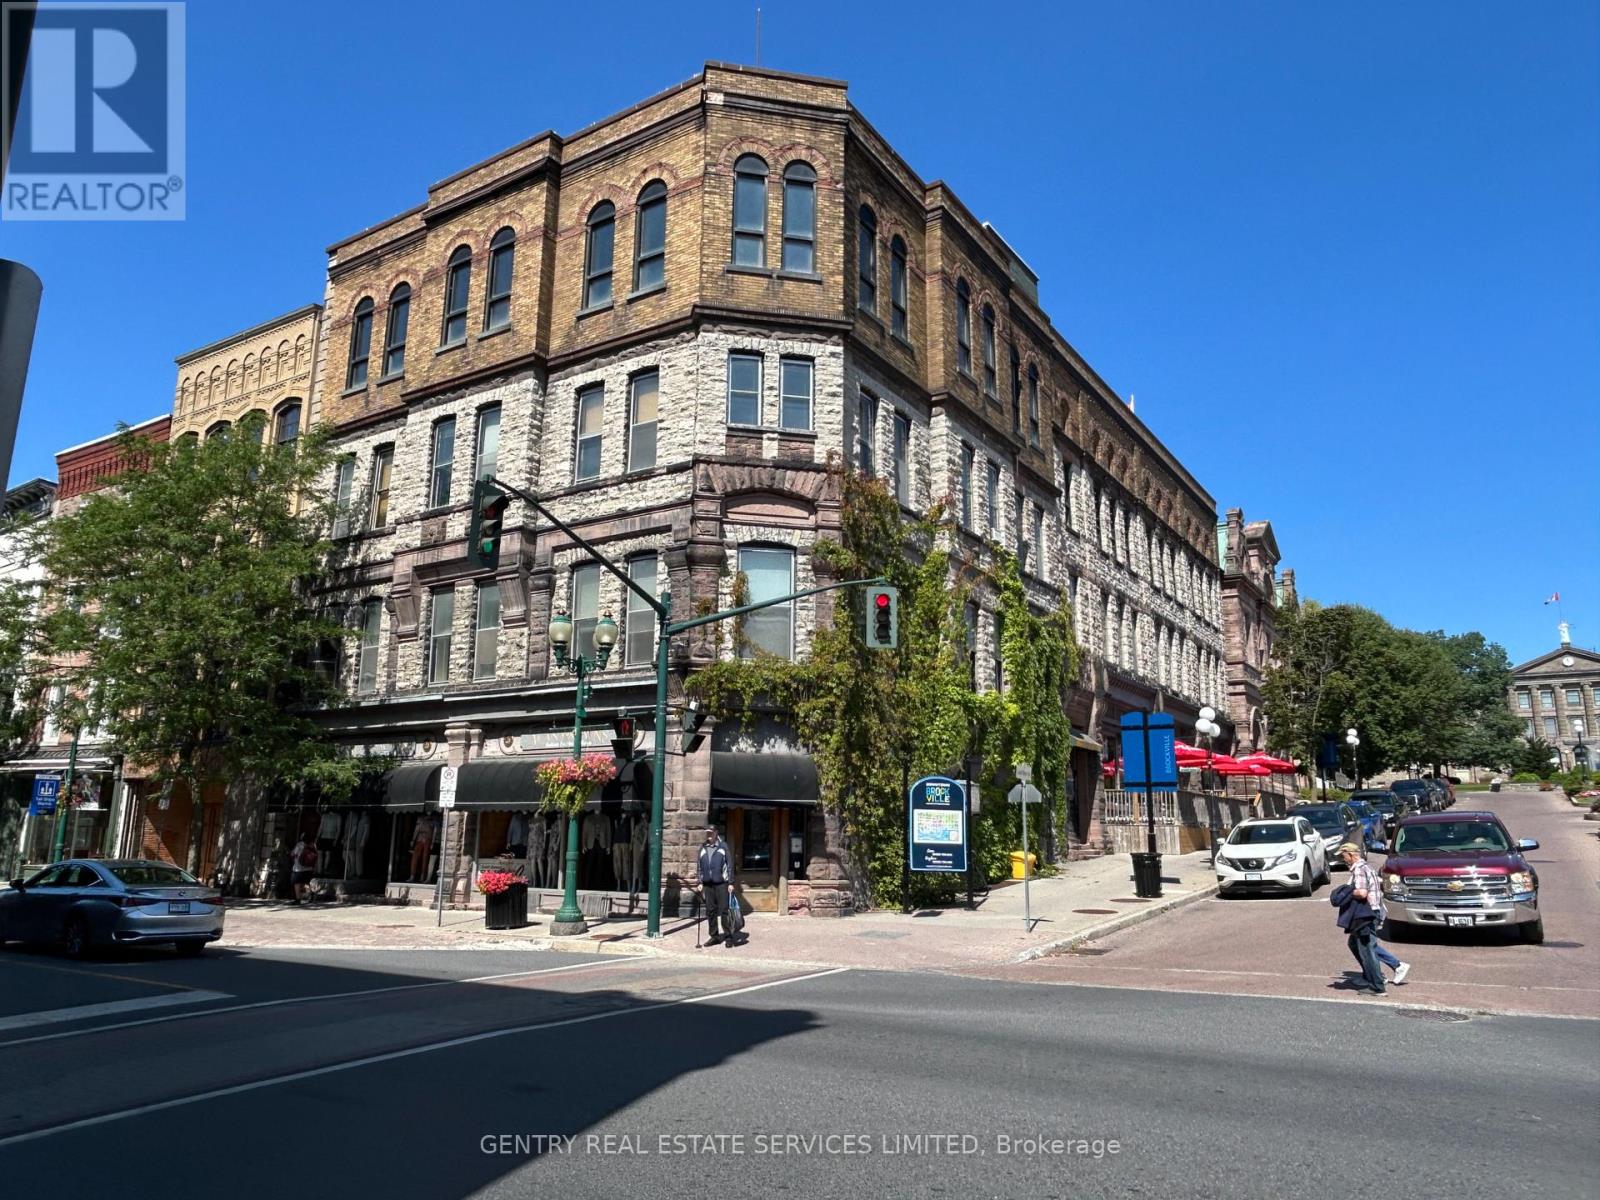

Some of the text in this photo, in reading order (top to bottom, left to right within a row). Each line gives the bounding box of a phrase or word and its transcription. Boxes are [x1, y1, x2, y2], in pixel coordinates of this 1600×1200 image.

[1163, 735, 1172, 774] BROCKVILLE
[925, 786, 950, 796] BROCK
[926, 795, 951, 803] VILLE
